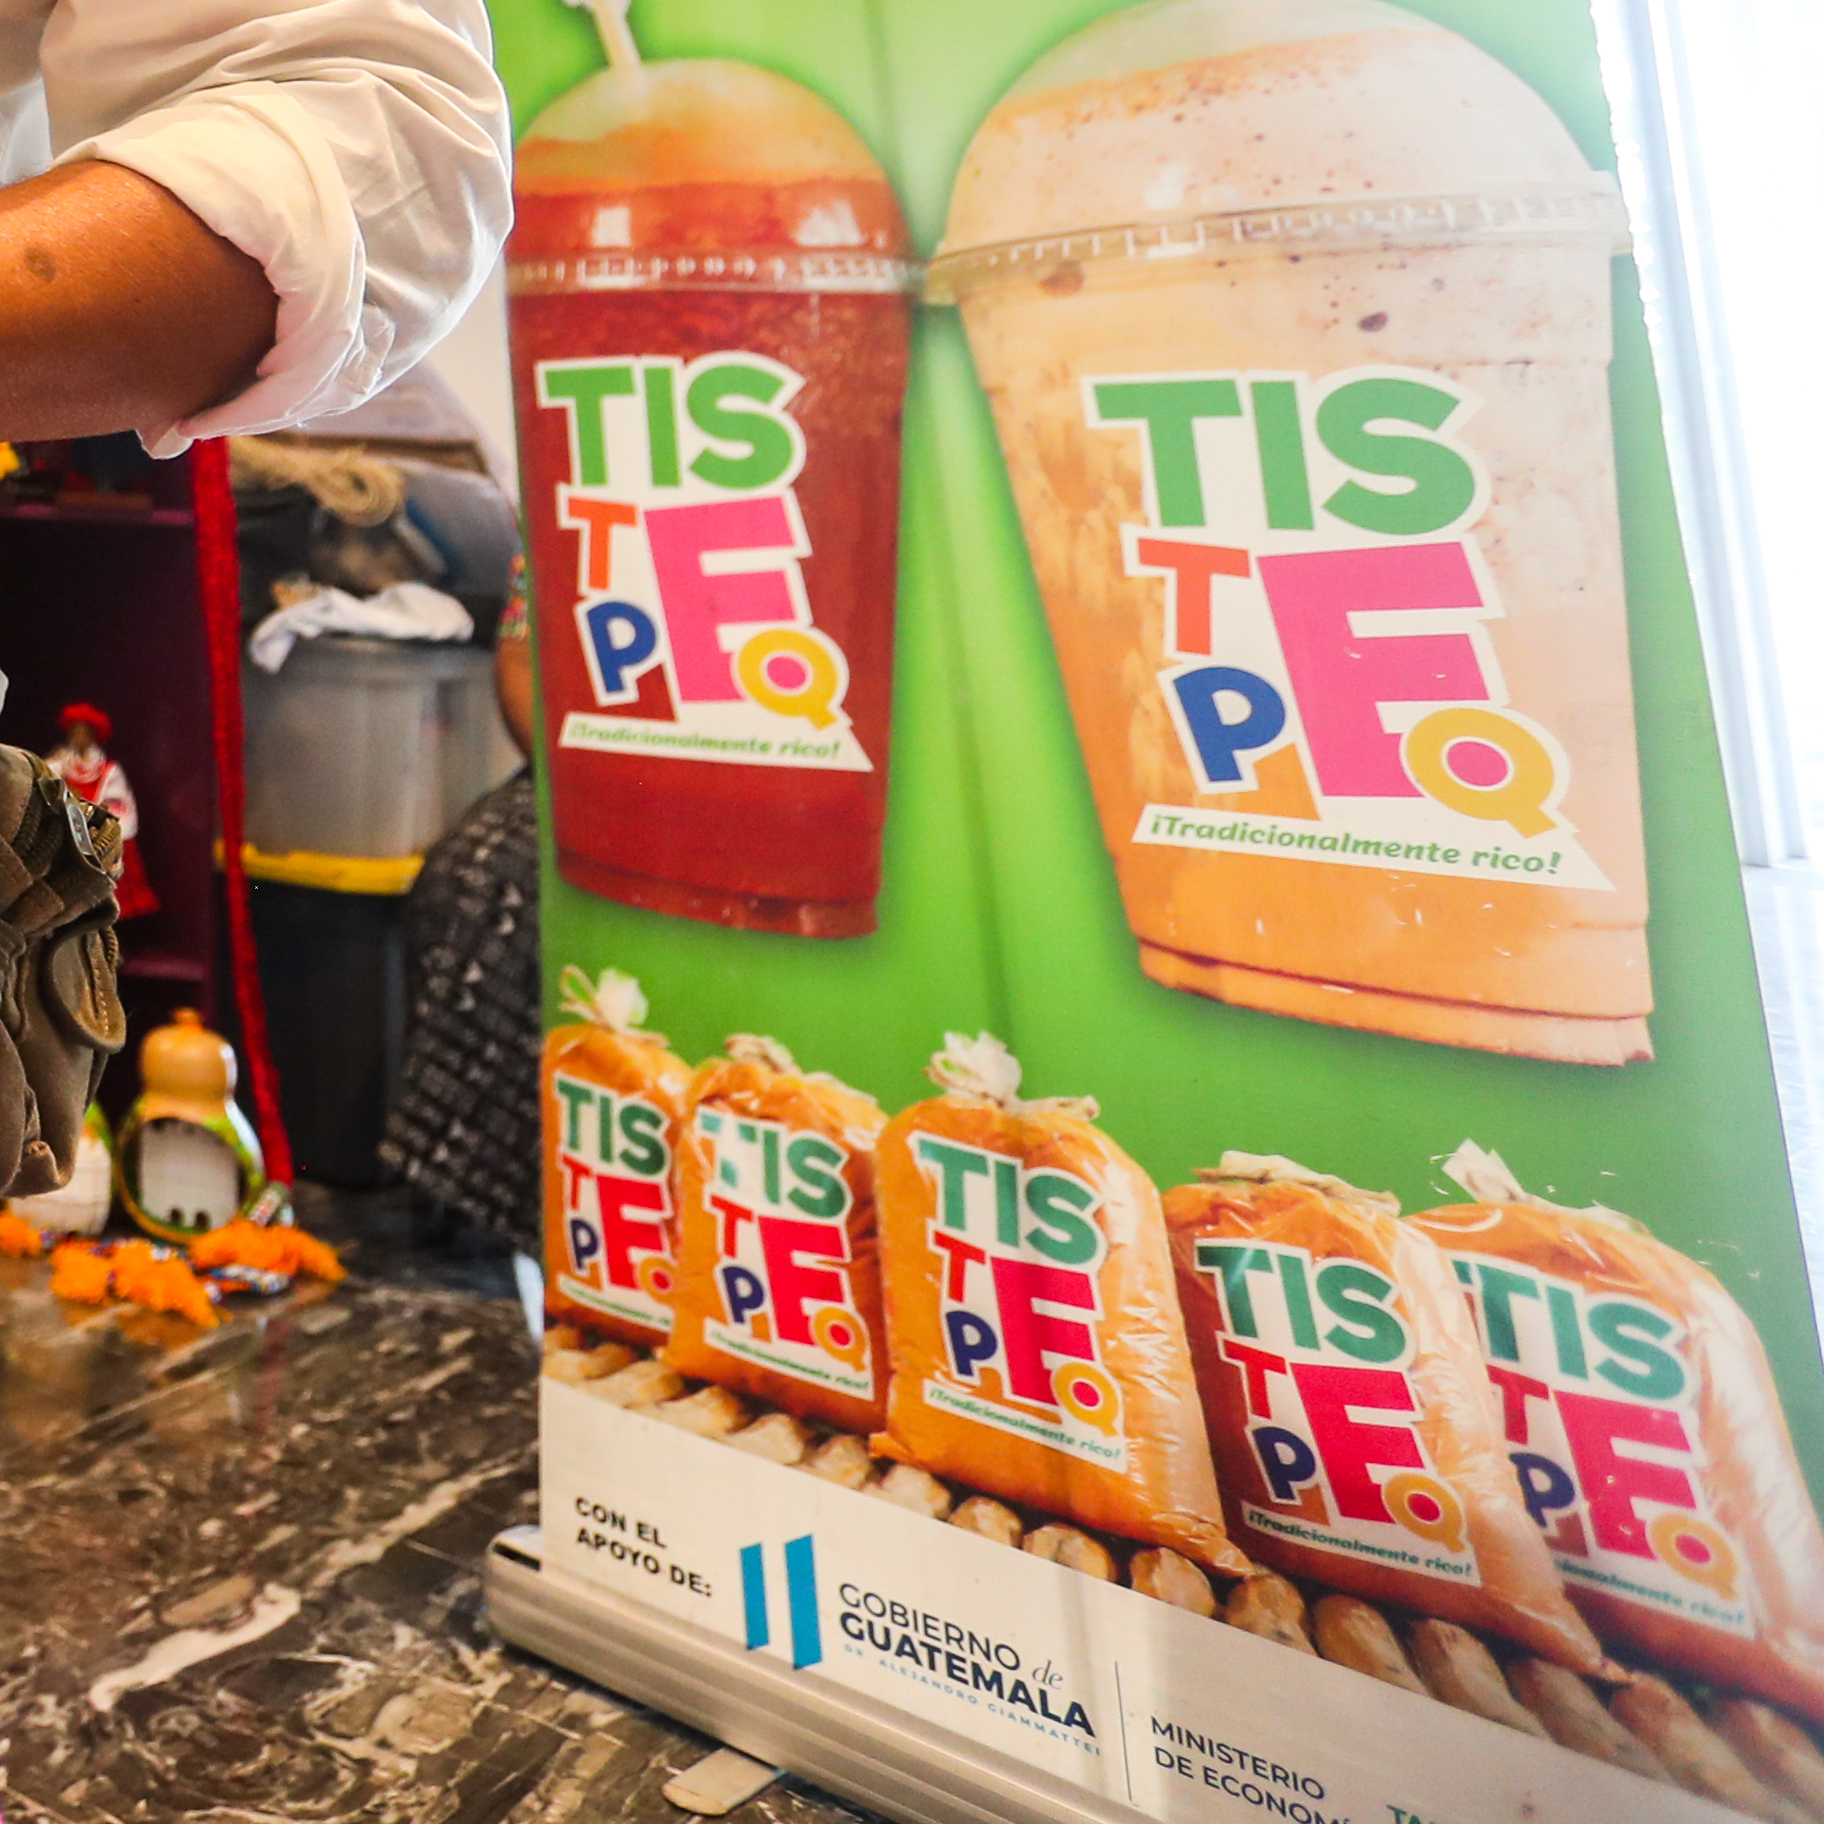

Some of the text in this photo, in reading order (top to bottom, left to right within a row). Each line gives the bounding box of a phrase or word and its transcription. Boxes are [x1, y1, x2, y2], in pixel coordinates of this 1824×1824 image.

[543, 363, 795, 490] TIS
[1093, 377, 1477, 536] TIS
[1149, 813, 1563, 875] ¡Tradicionalmente rico!
[555, 1078, 667, 1177] TIS
[918, 1138, 1099, 1265] TIS
[1196, 1245, 1407, 1364] TIS
[1452, 1259, 1686, 1402] TIS
[575, 1496, 668, 1549] CON EL
[576, 1526, 713, 1598] APOYO DE:
[1425, 1557, 1472, 1576] rico!
[839, 1582, 1064, 1691] GOBIERNO de
[839, 1611, 1097, 1739] GUATEMALA
[878, 1658, 979, 1705] ALEJANDRO
[987, 1703, 1102, 1757] GIAMMATTEI
[1149, 1715, 1326, 1800] MINISTERIO
[1153, 1746, 1196, 1780] DE
